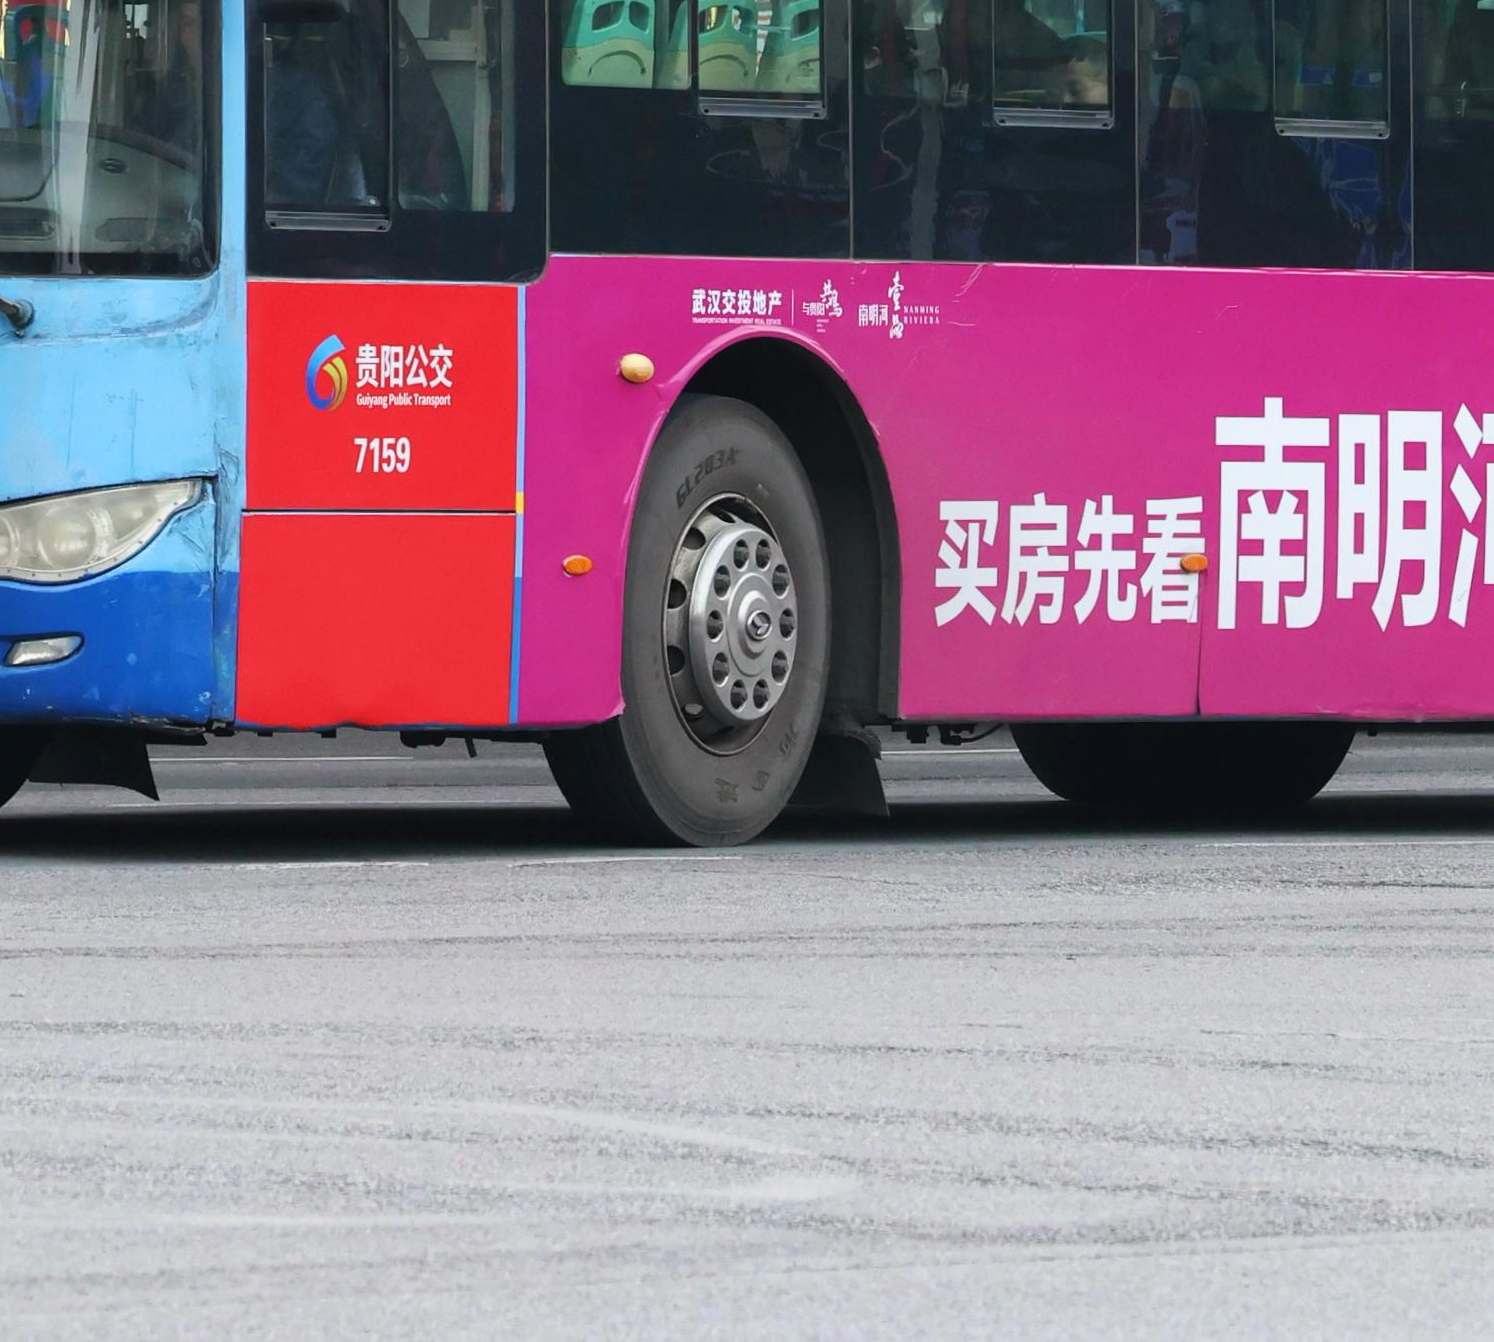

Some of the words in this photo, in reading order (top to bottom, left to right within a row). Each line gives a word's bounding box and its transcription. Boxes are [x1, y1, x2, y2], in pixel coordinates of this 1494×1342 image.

[691, 288, 782, 316] 武汉交投地产
[903, 305, 940, 314] NANMING
[858, 304, 889, 327] 南明河
[903, 315, 940, 325] RIVIERA
[355, 343, 453, 388] 贵阳公交
[356, 393, 388, 409] Guiyang
[388, 393, 413, 406] Public
[413, 393, 452, 408] Transport
[353, 436, 411, 473] 7159
[934, 492, 1207, 626] 买房先看
